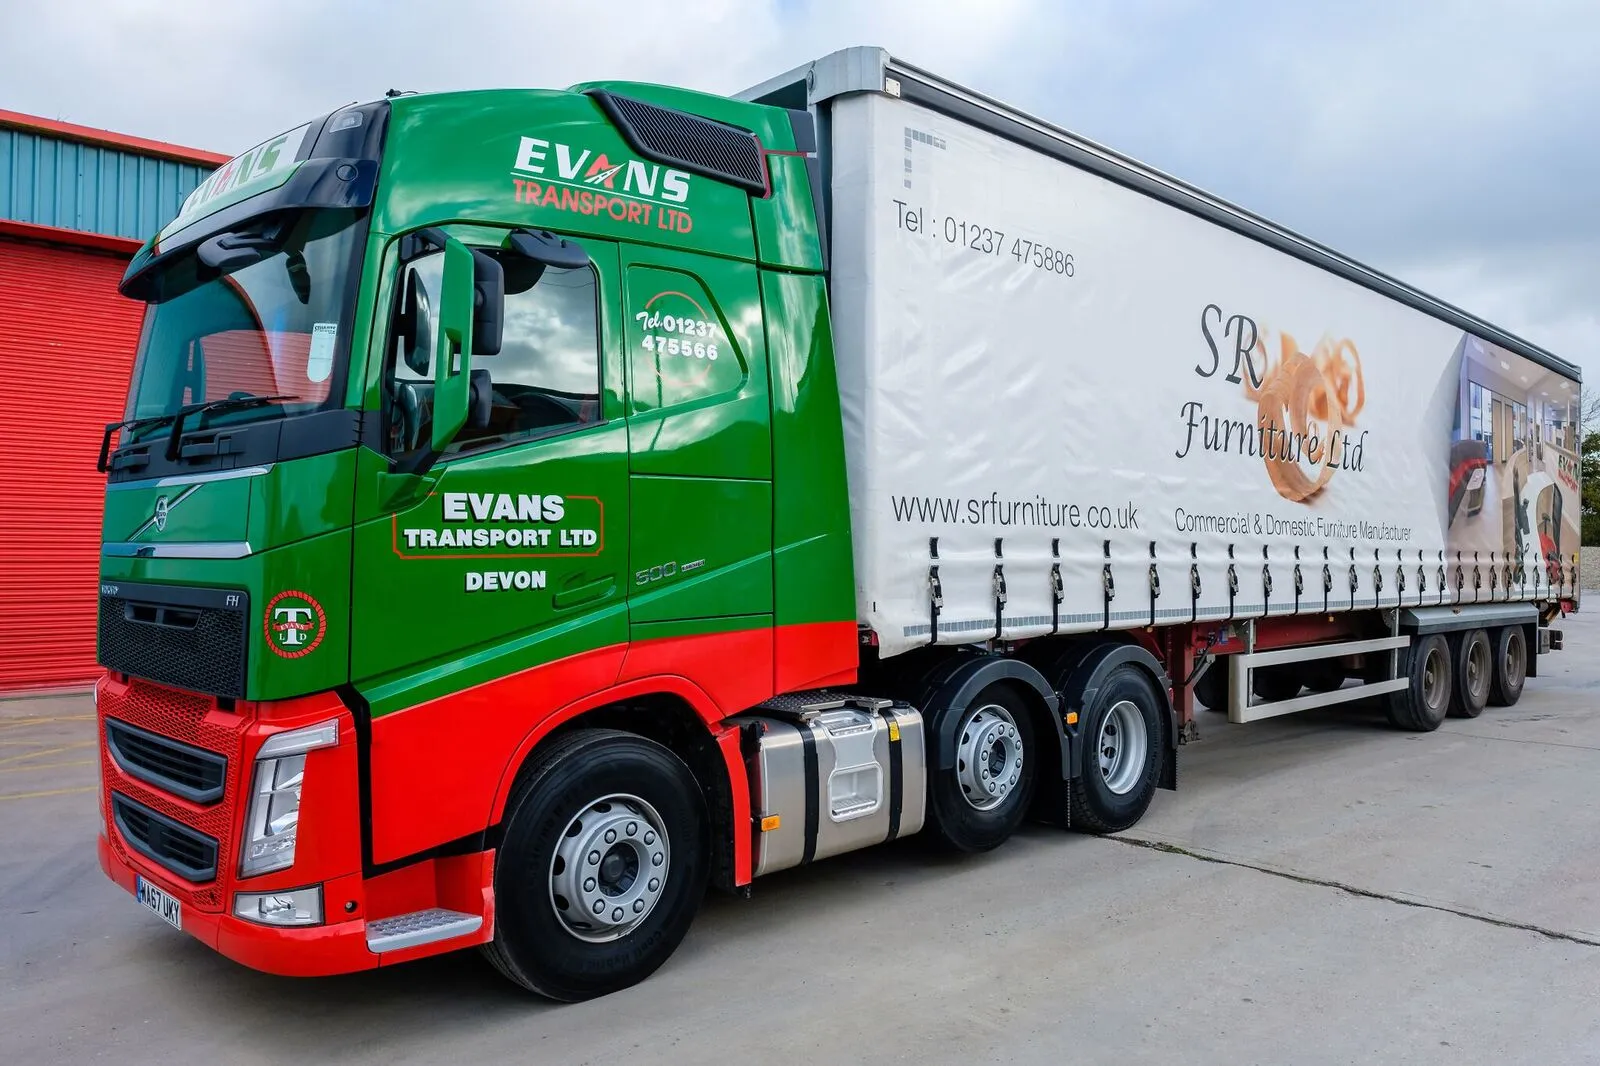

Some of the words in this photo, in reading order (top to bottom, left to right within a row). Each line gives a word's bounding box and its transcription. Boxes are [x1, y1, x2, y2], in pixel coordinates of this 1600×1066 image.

[513, 136, 691, 204] EVANS
[512, 179, 653, 226] TRANSPORT
[657, 209, 693, 234] LTD
[893, 199, 923, 234] Tel
[944, 216, 1005, 256] 01237
[1011, 238, 1075, 278] 475886
[663, 315, 718, 339] 01237
[641, 335, 719, 361] 475566
[1194, 303, 1264, 389] SR
[1175, 401, 1322, 465] Furniture
[1326, 429, 1369, 473] Ltd
[443, 492, 566, 523] EVANS
[891, 491, 1140, 530] www.srfurniture.co.uk
[403, 528, 552, 549] TRANSPORT
[559, 528, 598, 548] LTD
[1175, 507, 1251, 534] Commercial
[1253, 513, 1263, 535] &
[1266, 513, 1315, 537] Domestic
[1317, 517, 1358, 539] Furniture
[1359, 520, 1412, 542] Manufacturer
[465, 570, 547, 592] DEVON
[635, 561, 676, 586] 500
[226, 594, 240, 607] FH
[280, 620, 305, 631] EVANS
[162, 894, 179, 925] UKY
